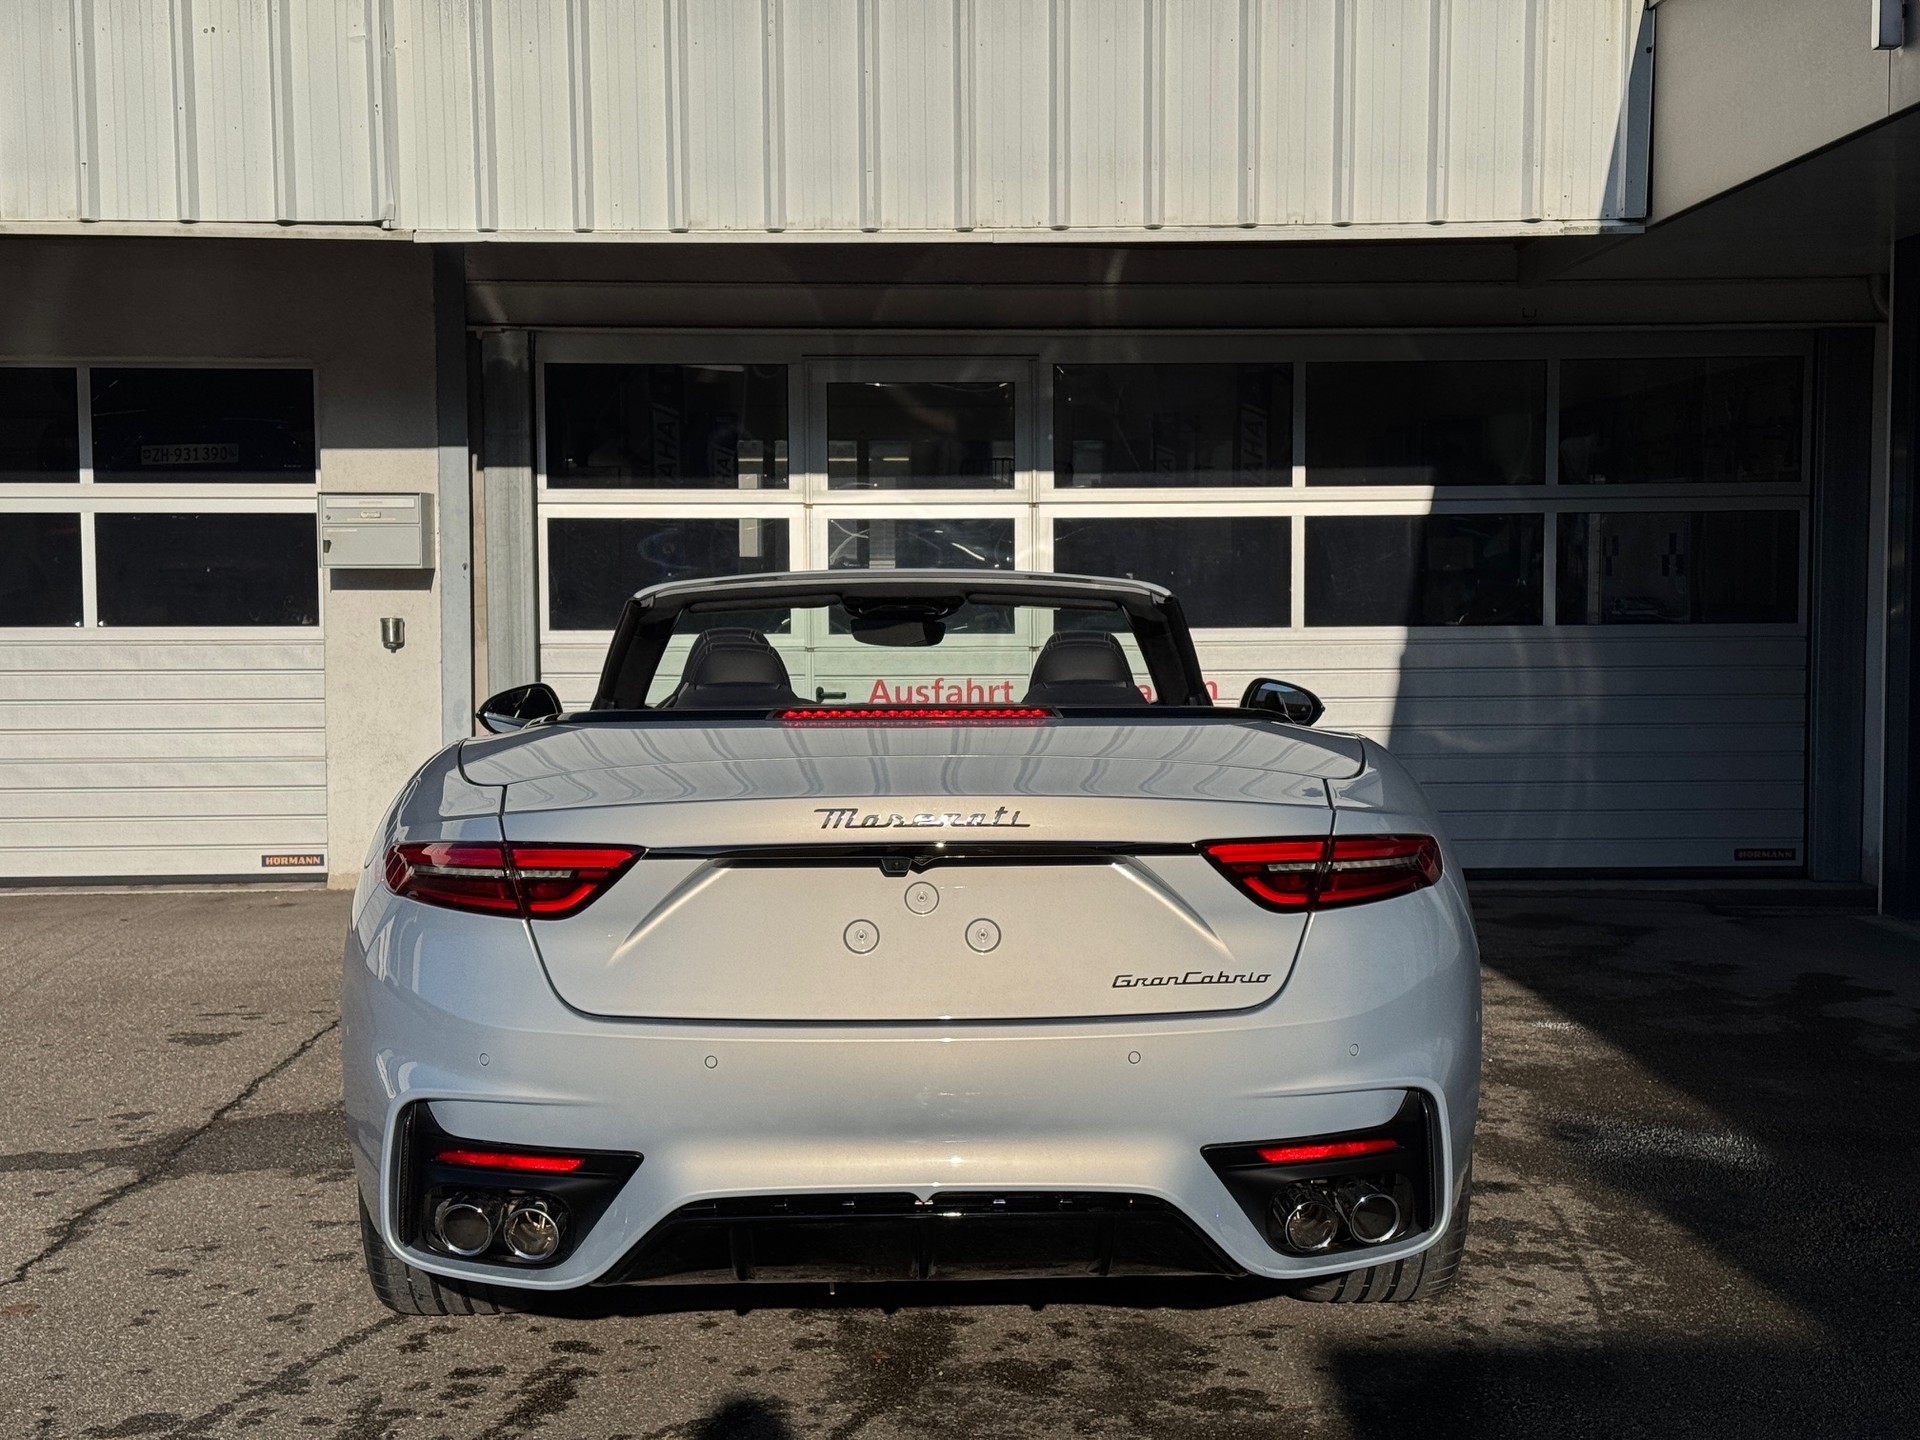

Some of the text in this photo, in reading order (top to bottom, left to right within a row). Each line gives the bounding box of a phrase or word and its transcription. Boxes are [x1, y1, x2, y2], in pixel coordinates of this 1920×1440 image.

[868, 678, 1014, 704] Ausfahrt
[813, 806, 1031, 829] Maserati
[1111, 971, 1272, 988] GranCabrio
